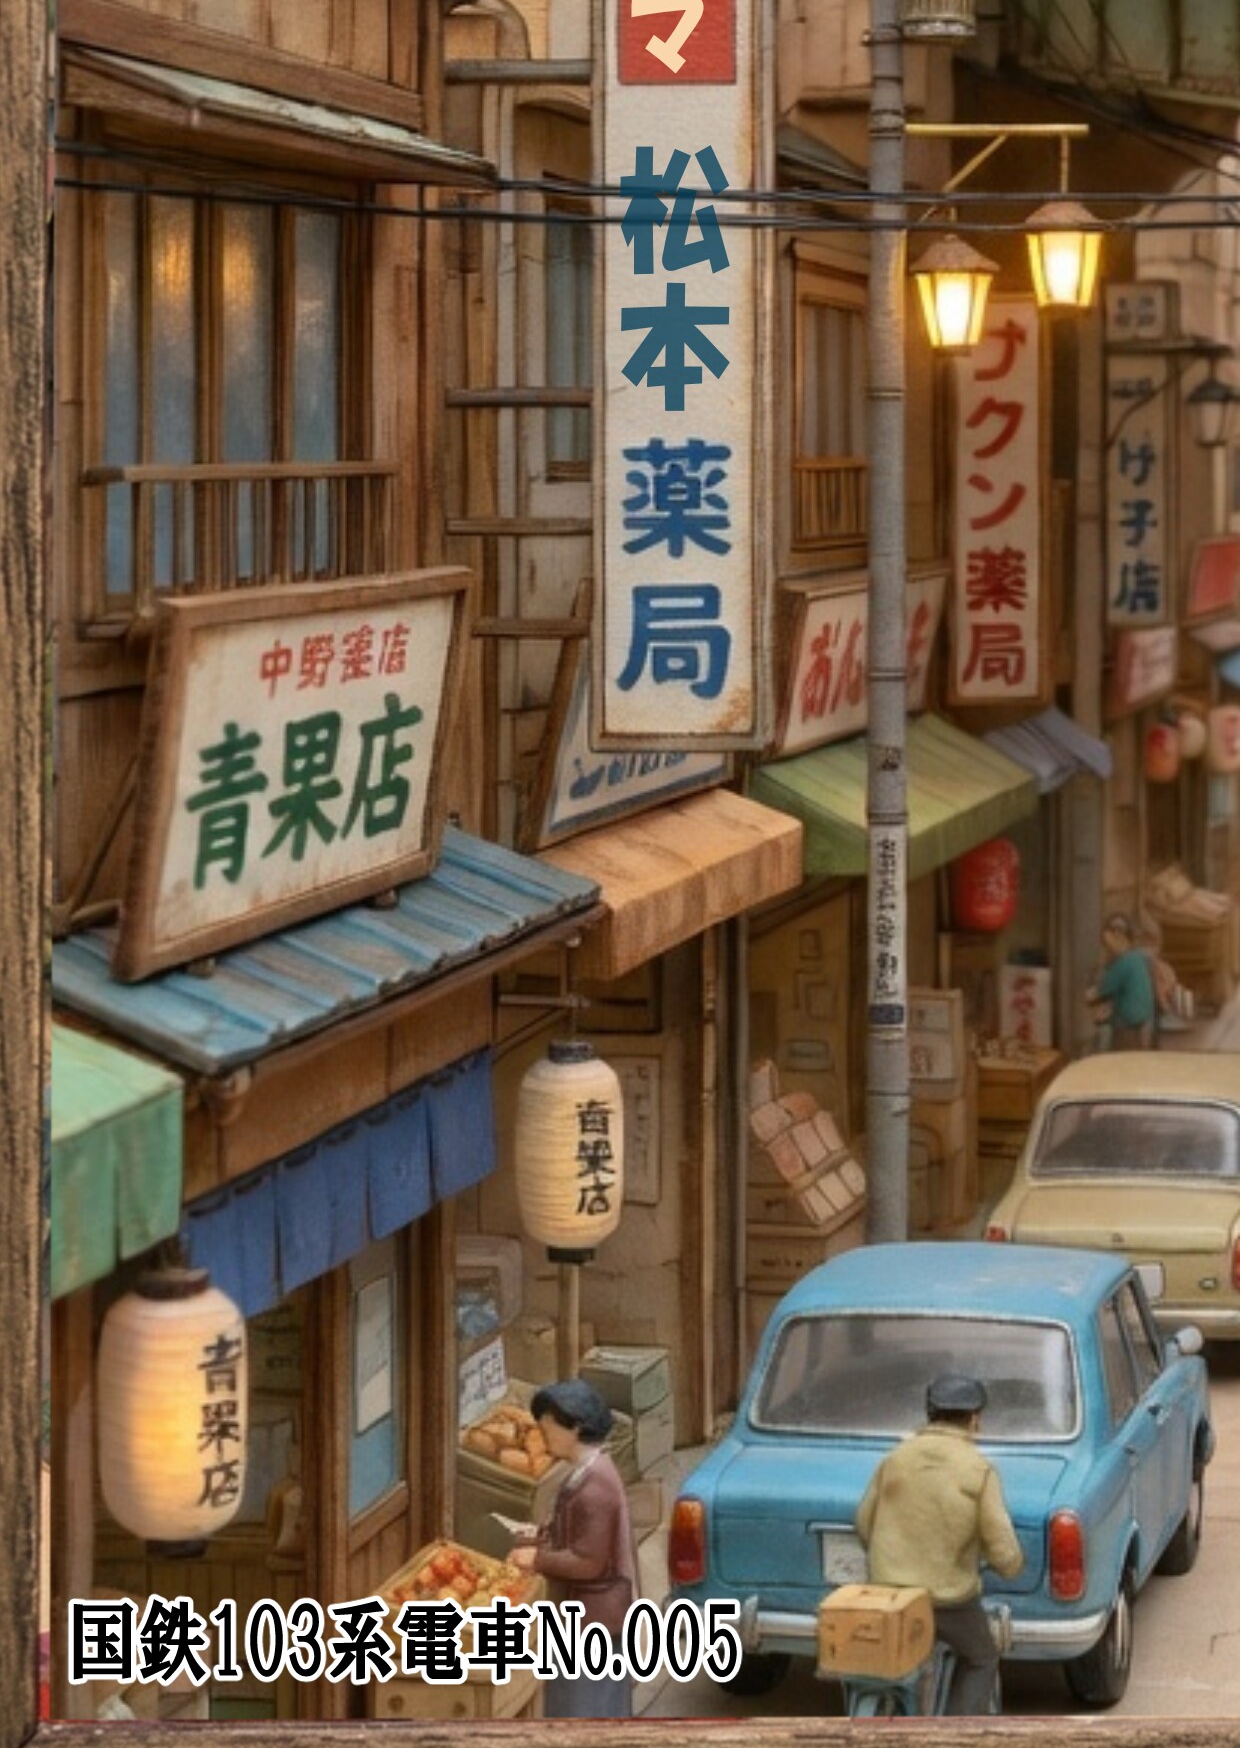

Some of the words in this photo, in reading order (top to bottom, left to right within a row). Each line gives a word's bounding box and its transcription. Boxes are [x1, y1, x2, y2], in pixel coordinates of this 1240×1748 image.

[616, 145, 732, 700] 松本薬局
[185, 692, 424, 890] 青果店
